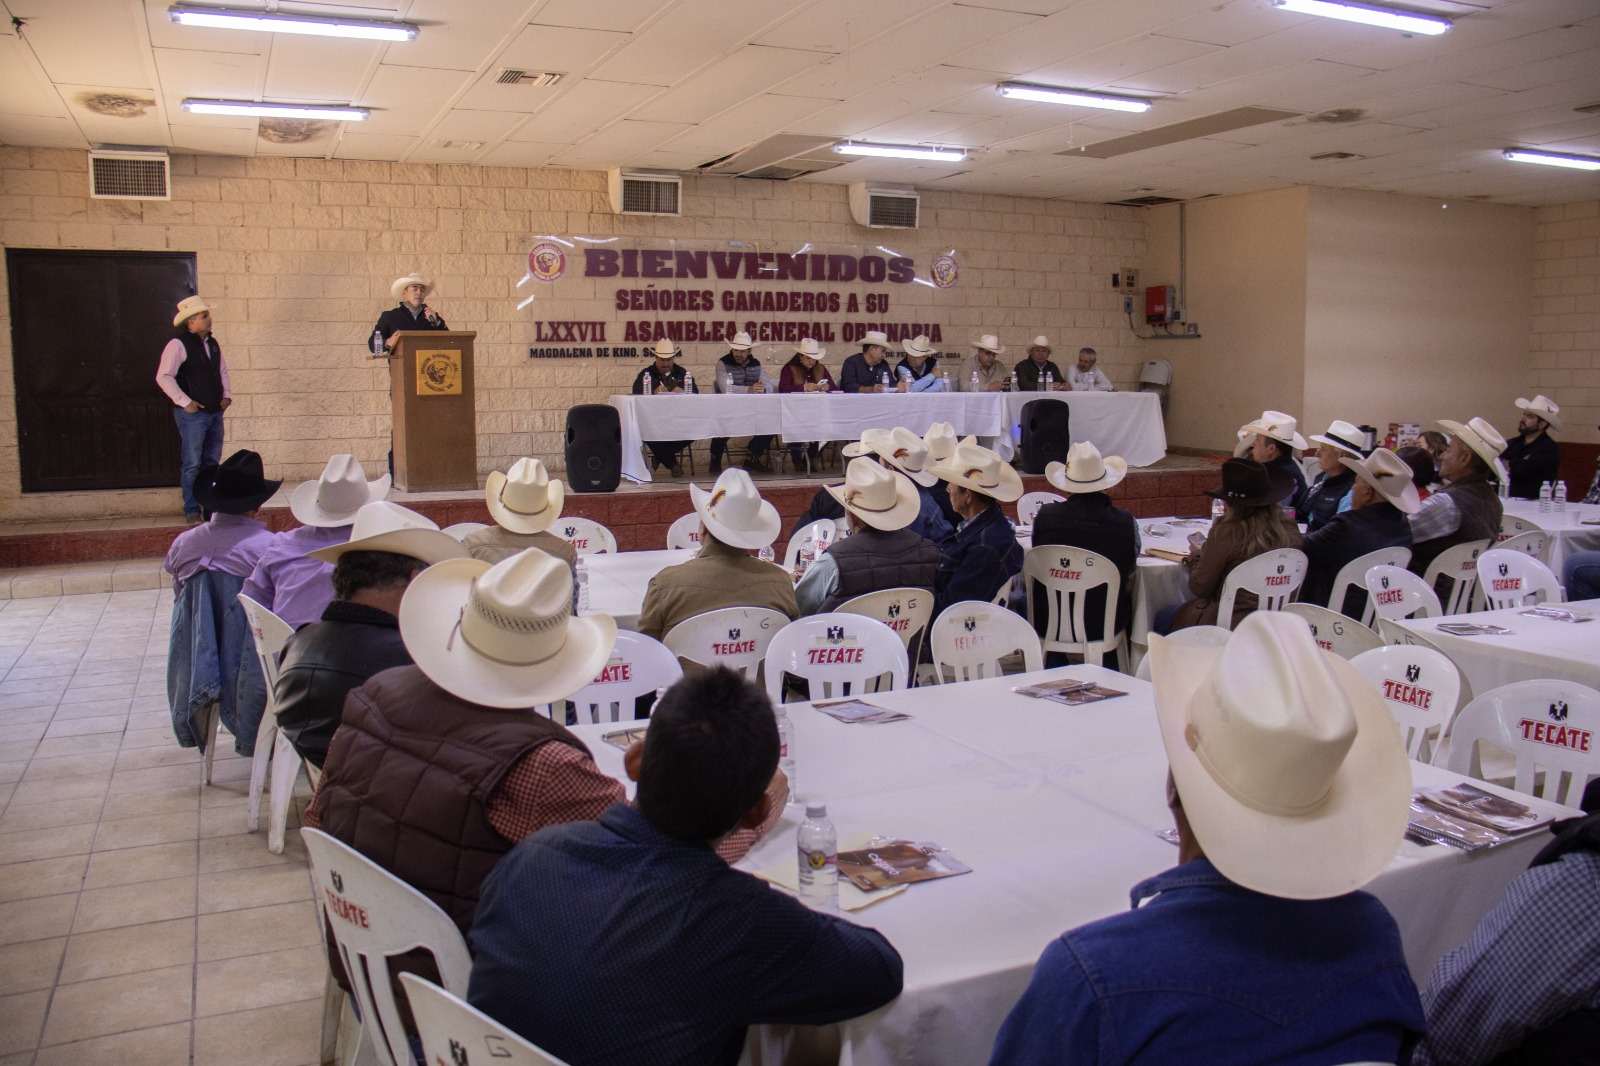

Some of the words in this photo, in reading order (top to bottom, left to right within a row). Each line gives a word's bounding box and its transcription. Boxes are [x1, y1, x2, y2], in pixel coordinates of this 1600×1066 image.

[584, 249, 916, 283] BIENVENIDOS
[616, 284, 714, 311] SEÑORES
[722, 290, 840, 313] GANADEROS
[847, 293, 859, 313] A
[866, 294, 889, 313] SU
[535, 321, 606, 342] LXXVII
[624, 320, 738, 342] ASAMBLEA
[744, 321, 836, 342] GENERAL
[530, 348, 593, 358] MAGDALENA
[596, 347, 610, 358] DE
[643, 347, 682, 358] SOA
[1050, 568, 1082, 580] TECATE
[1265, 575, 1291, 586] TECATE
[1491, 578, 1521, 591] TECATE
[1376, 589, 1404, 606] TECATE
[882, 618, 910, 631] CATE
[713, 640, 755, 655] TECATE
[807, 647, 865, 664] TECATE
[593, 664, 632, 684] ATE
[1383, 680, 1433, 709] TECATE
[1519, 719, 1592, 752] TECATE
